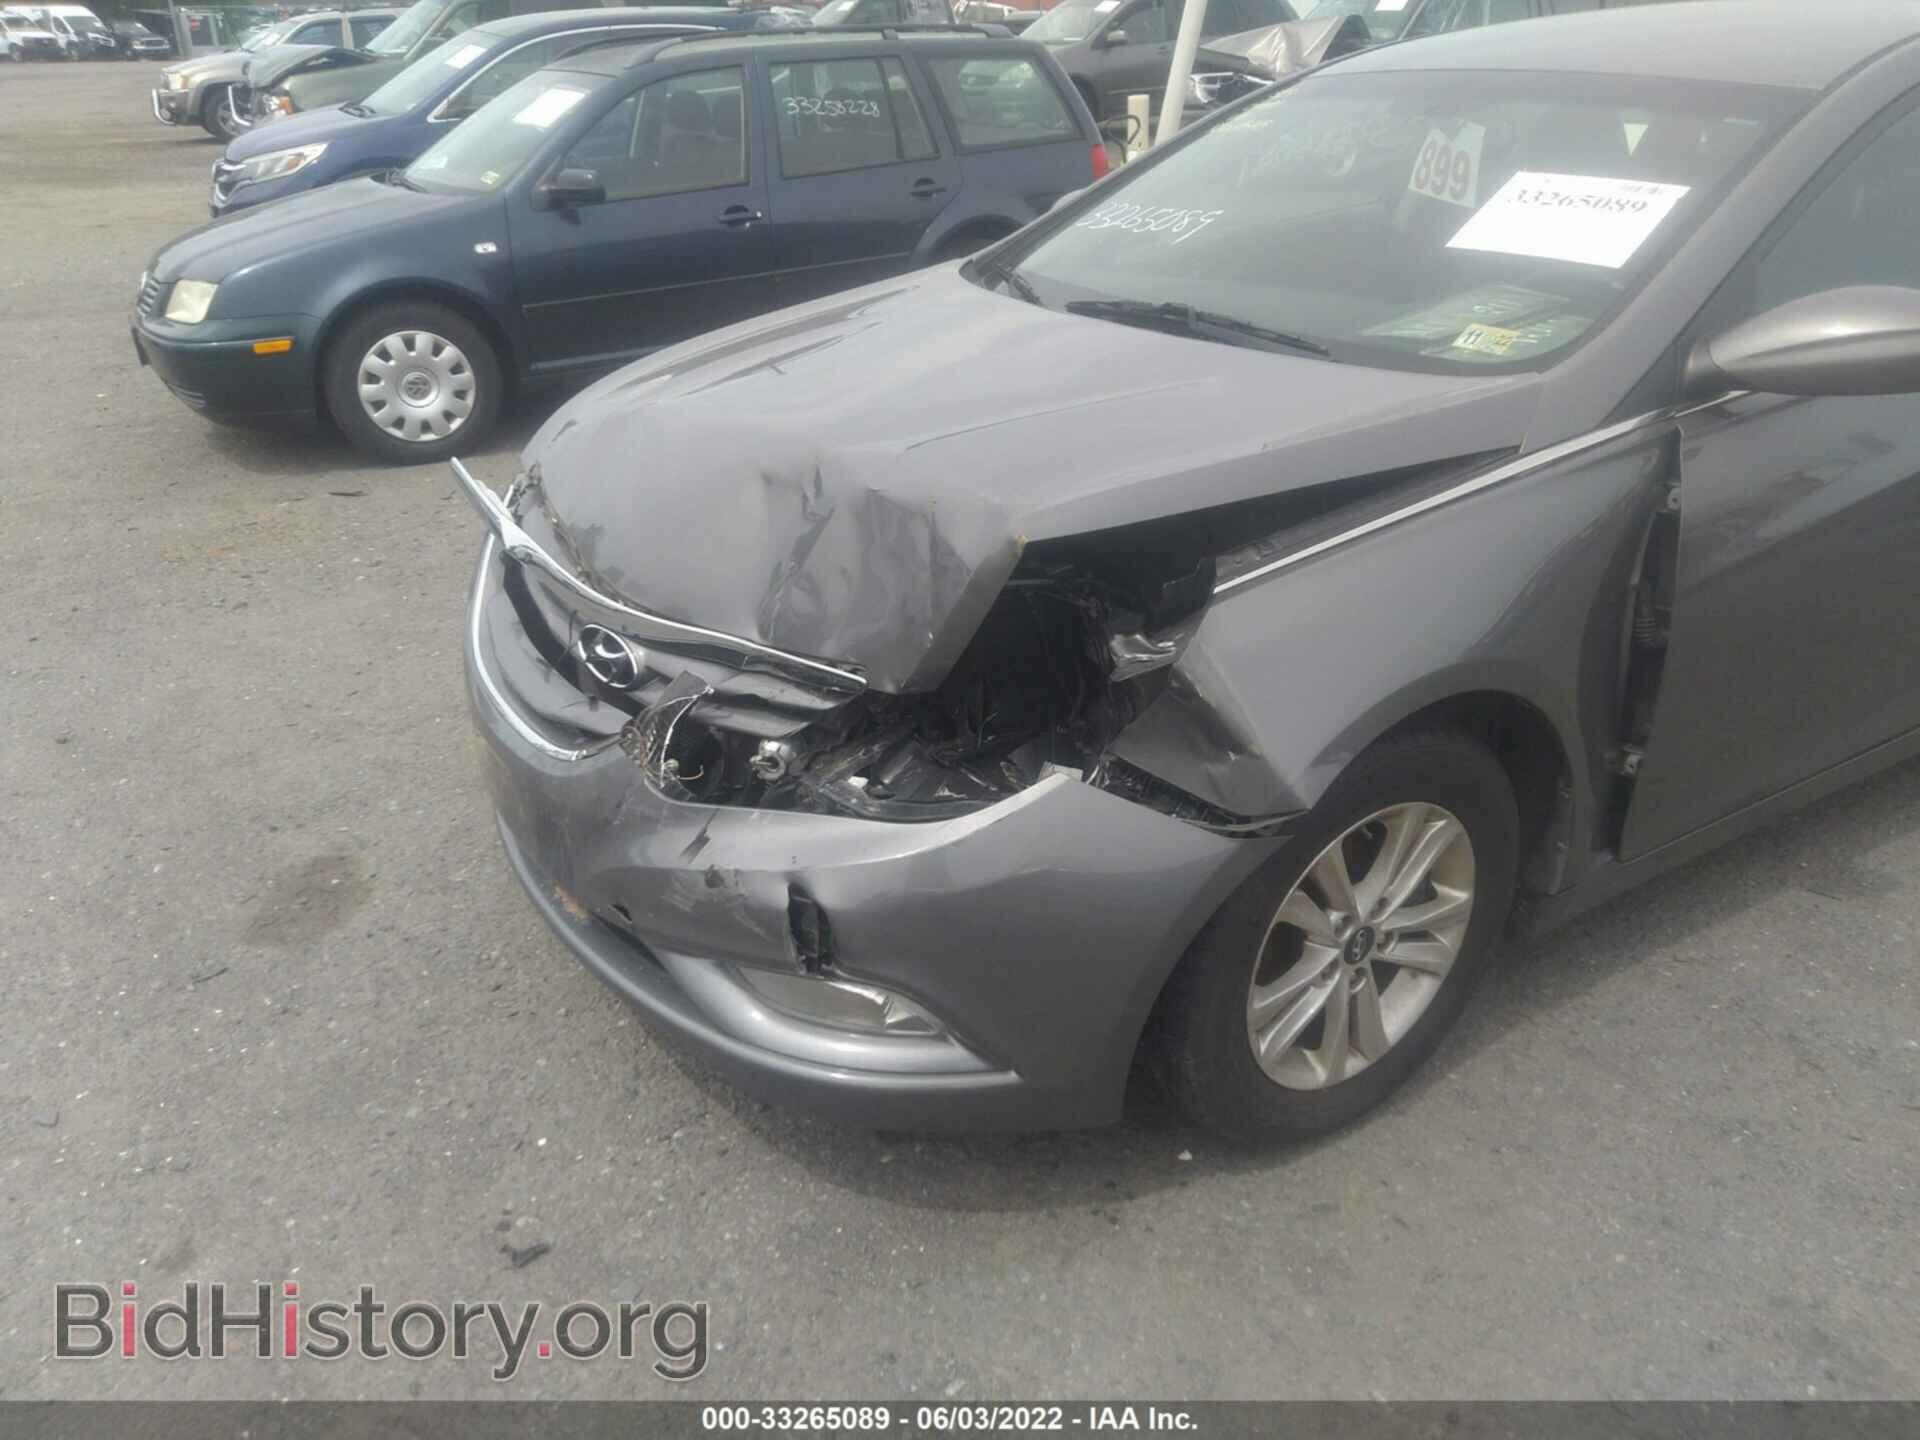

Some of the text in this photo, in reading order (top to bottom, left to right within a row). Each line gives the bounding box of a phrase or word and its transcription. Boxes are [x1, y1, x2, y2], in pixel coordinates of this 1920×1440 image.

[782, 96, 880, 117] 33258228
[1415, 138, 1469, 200] 899
[1506, 188, 1648, 214] 33265089
